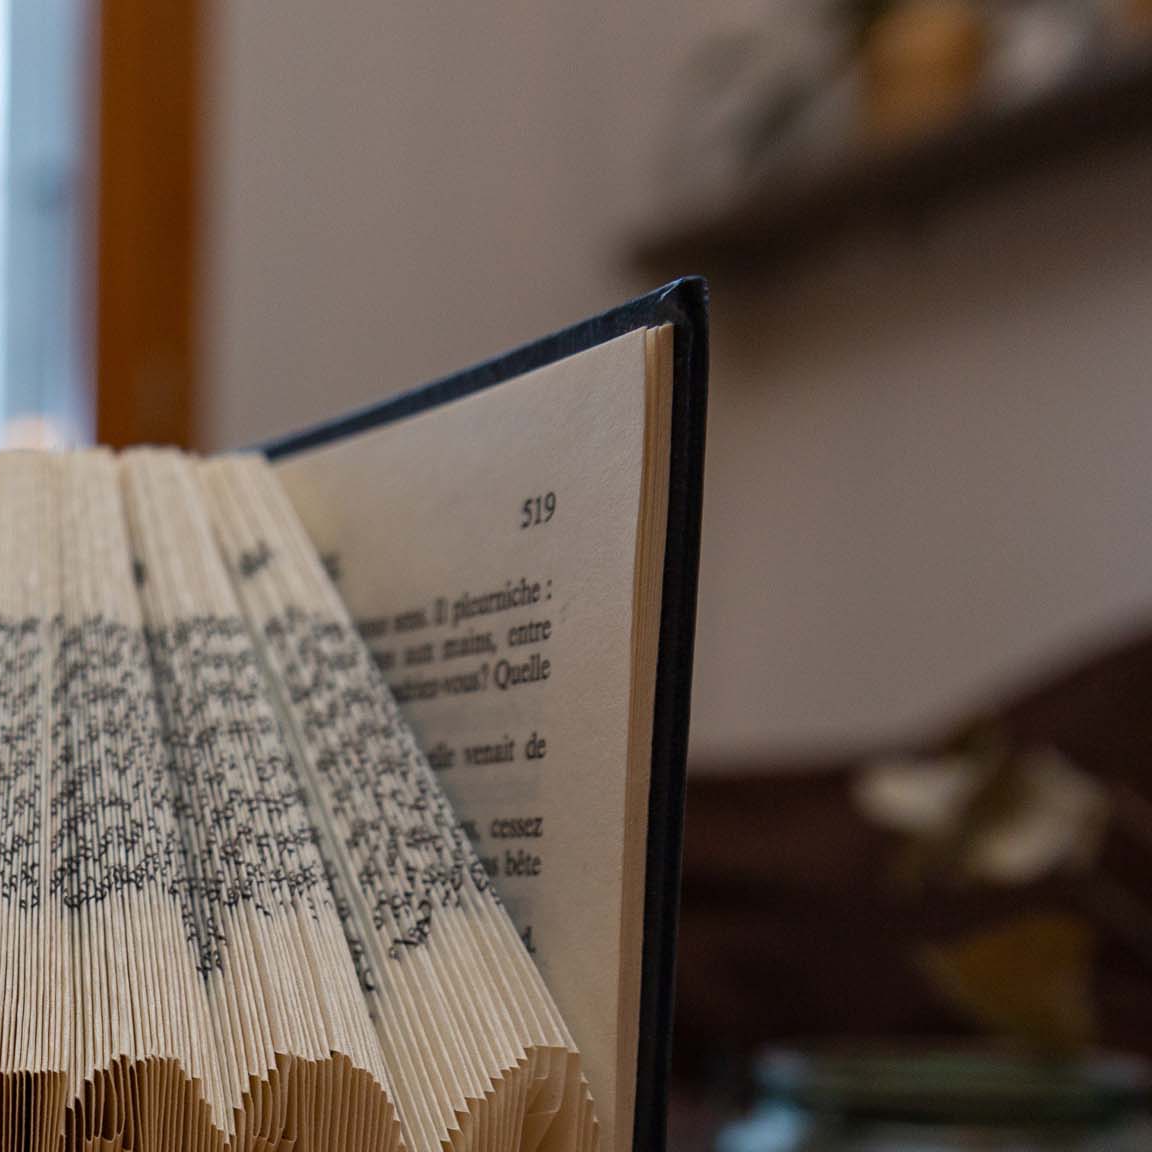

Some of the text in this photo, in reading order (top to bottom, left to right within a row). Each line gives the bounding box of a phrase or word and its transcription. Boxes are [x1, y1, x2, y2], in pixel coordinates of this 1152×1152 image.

[520, 491, 557, 529] 519
[508, 619, 552, 648] entre
[493, 652, 551, 691] Quelle
[525, 731, 546, 760] de
[490, 817, 544, 838] cessez
[505, 849, 542, 878] bête
